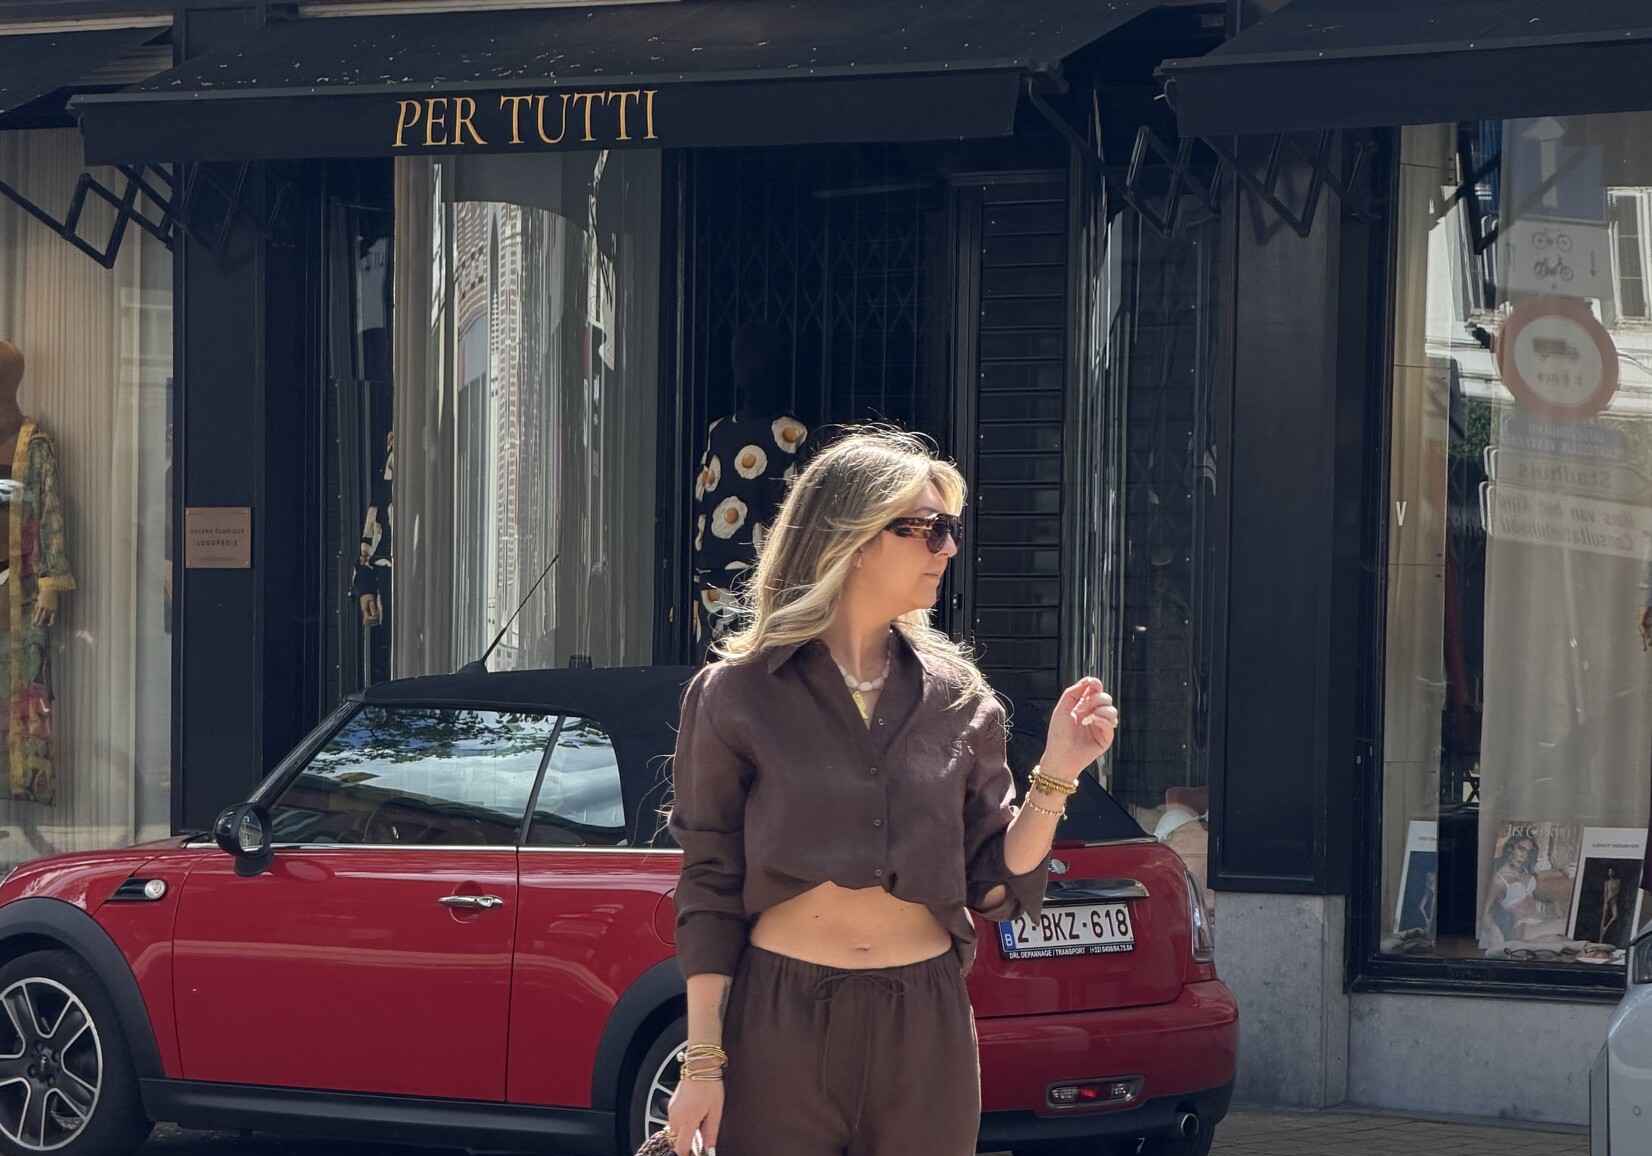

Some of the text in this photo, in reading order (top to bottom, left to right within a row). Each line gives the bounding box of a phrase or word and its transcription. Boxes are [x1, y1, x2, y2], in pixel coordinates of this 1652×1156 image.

[391, 89, 659, 147] PER TUTTI
[1004, 933, 1013, 947] B
[1021, 950, 1052, 959] DEPANNAGE
[1055, 947, 1085, 956] TRANSPORT
